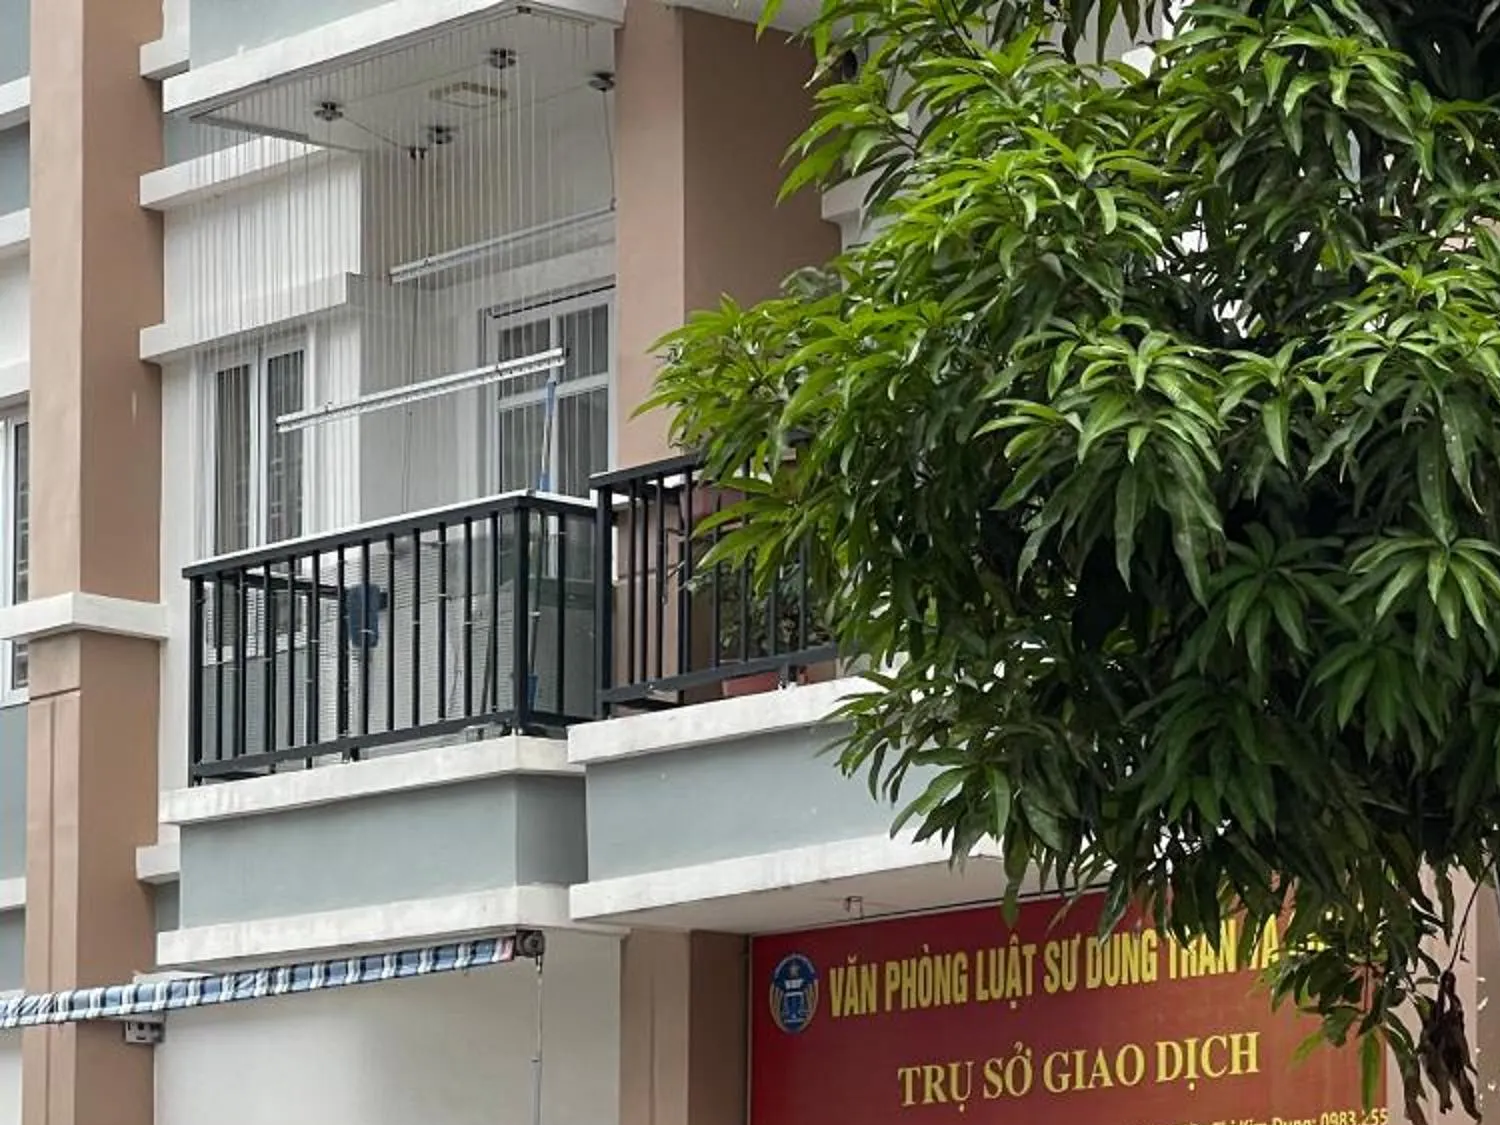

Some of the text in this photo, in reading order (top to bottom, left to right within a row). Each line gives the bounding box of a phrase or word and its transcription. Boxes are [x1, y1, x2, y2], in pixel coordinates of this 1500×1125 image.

[829, 955, 879, 1017] VĂN
[884, 944, 969, 1011] PHÒNG
[975, 932, 1038, 1009] LUẬT
[1044, 933, 1081, 993] SƯ
[898, 1031, 1260, 1112] TRỤ SỞ GIAO DỊCH
